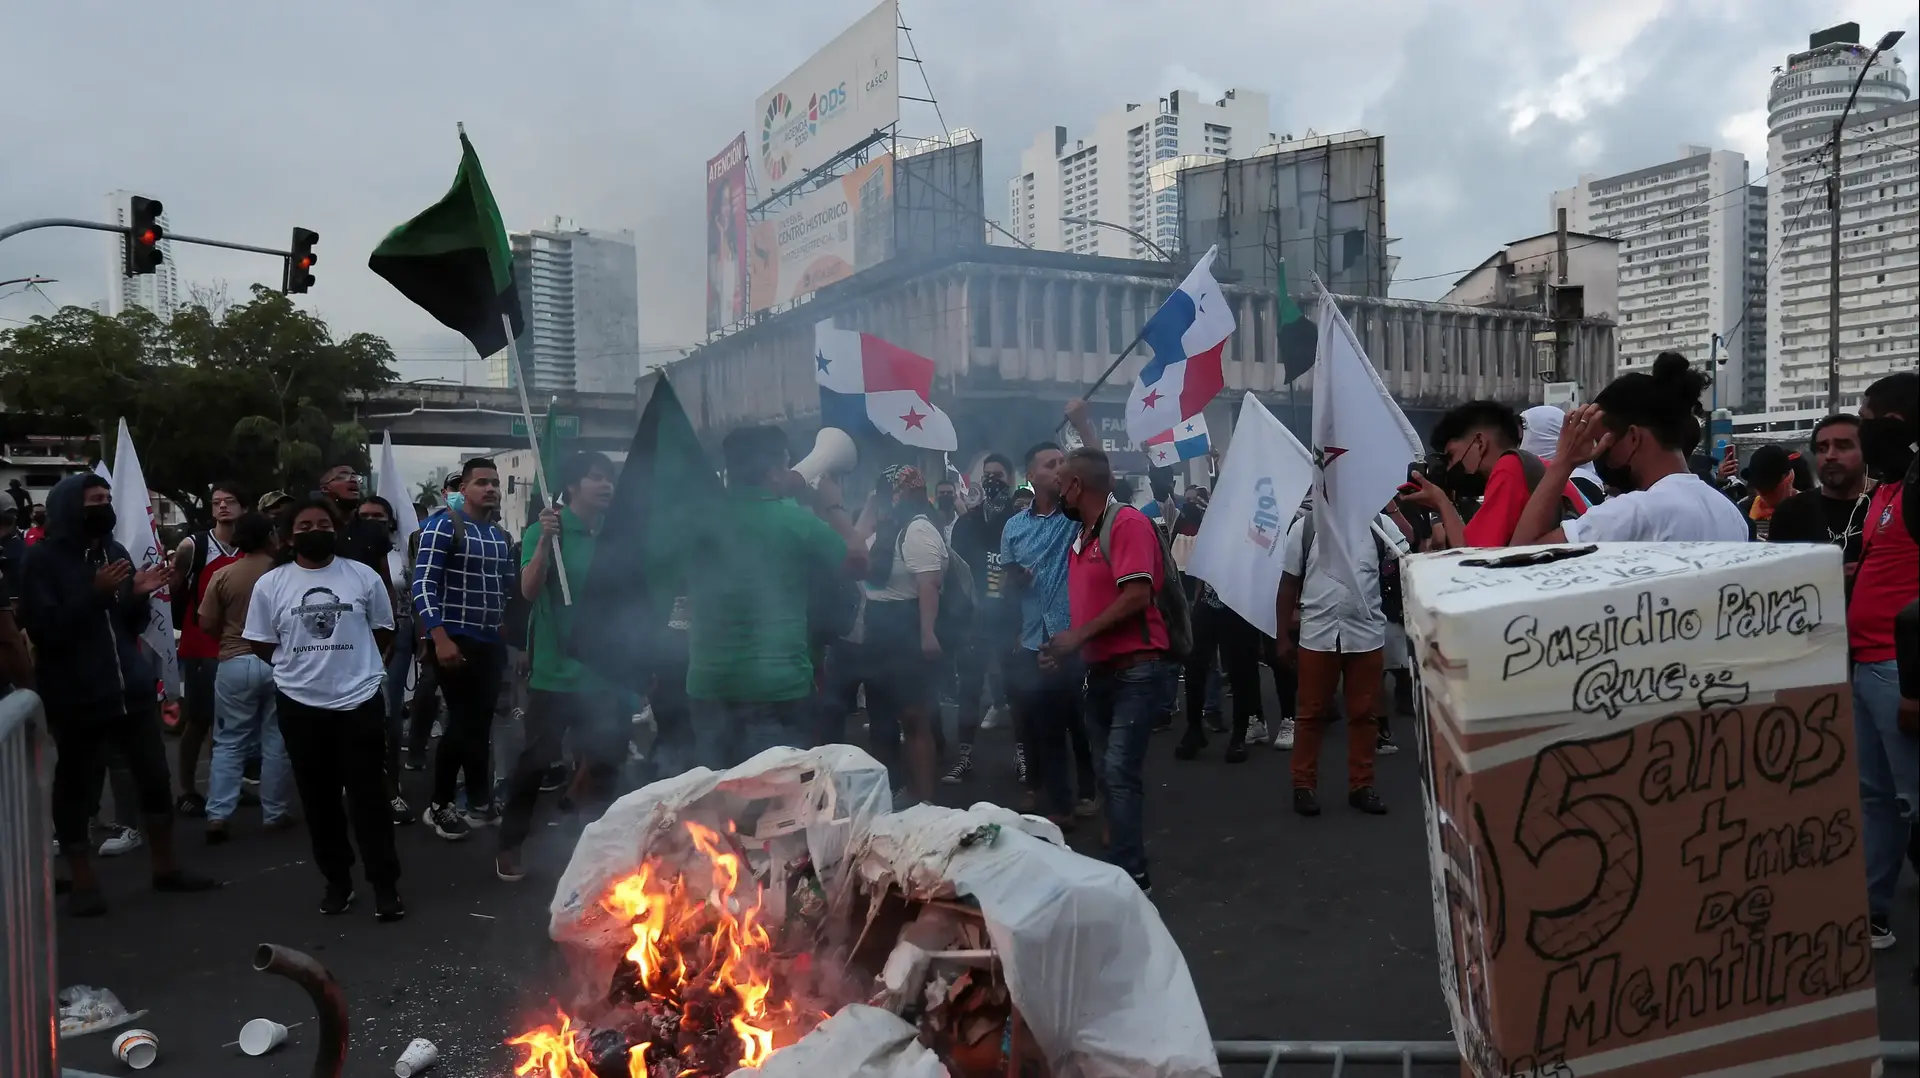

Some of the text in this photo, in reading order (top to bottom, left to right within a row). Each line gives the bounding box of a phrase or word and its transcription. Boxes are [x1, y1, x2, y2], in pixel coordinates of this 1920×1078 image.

[819, 81, 846, 115] ODS
[865, 70, 888, 91] CASCO
[708, 142, 742, 183] ATENCIÓN
[778, 223, 806, 246] CENTRO
[1102, 439, 1120, 452] EL
[1714, 583, 1822, 641] Para
[1513, 730, 1644, 963] 5
[1681, 797, 1857, 883] + mas
[1533, 914, 1874, 1056] Mentiras
